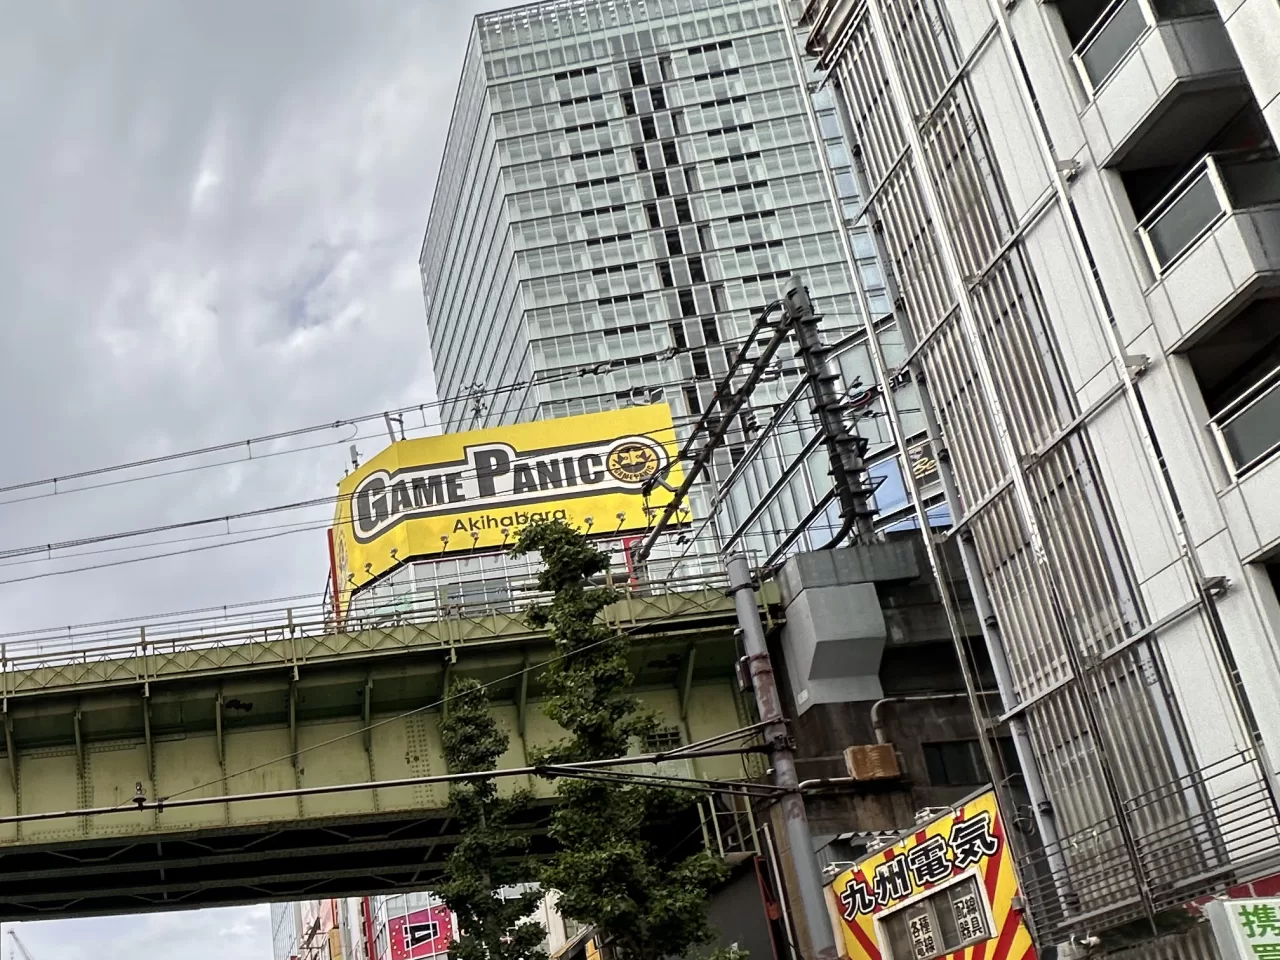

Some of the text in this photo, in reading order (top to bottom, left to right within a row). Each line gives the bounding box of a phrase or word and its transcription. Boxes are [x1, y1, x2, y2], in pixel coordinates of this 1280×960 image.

[357, 448, 607, 535] GAME PANIC
[453, 507, 567, 534] Akihabara
[840, 811, 999, 922] 九州電気
